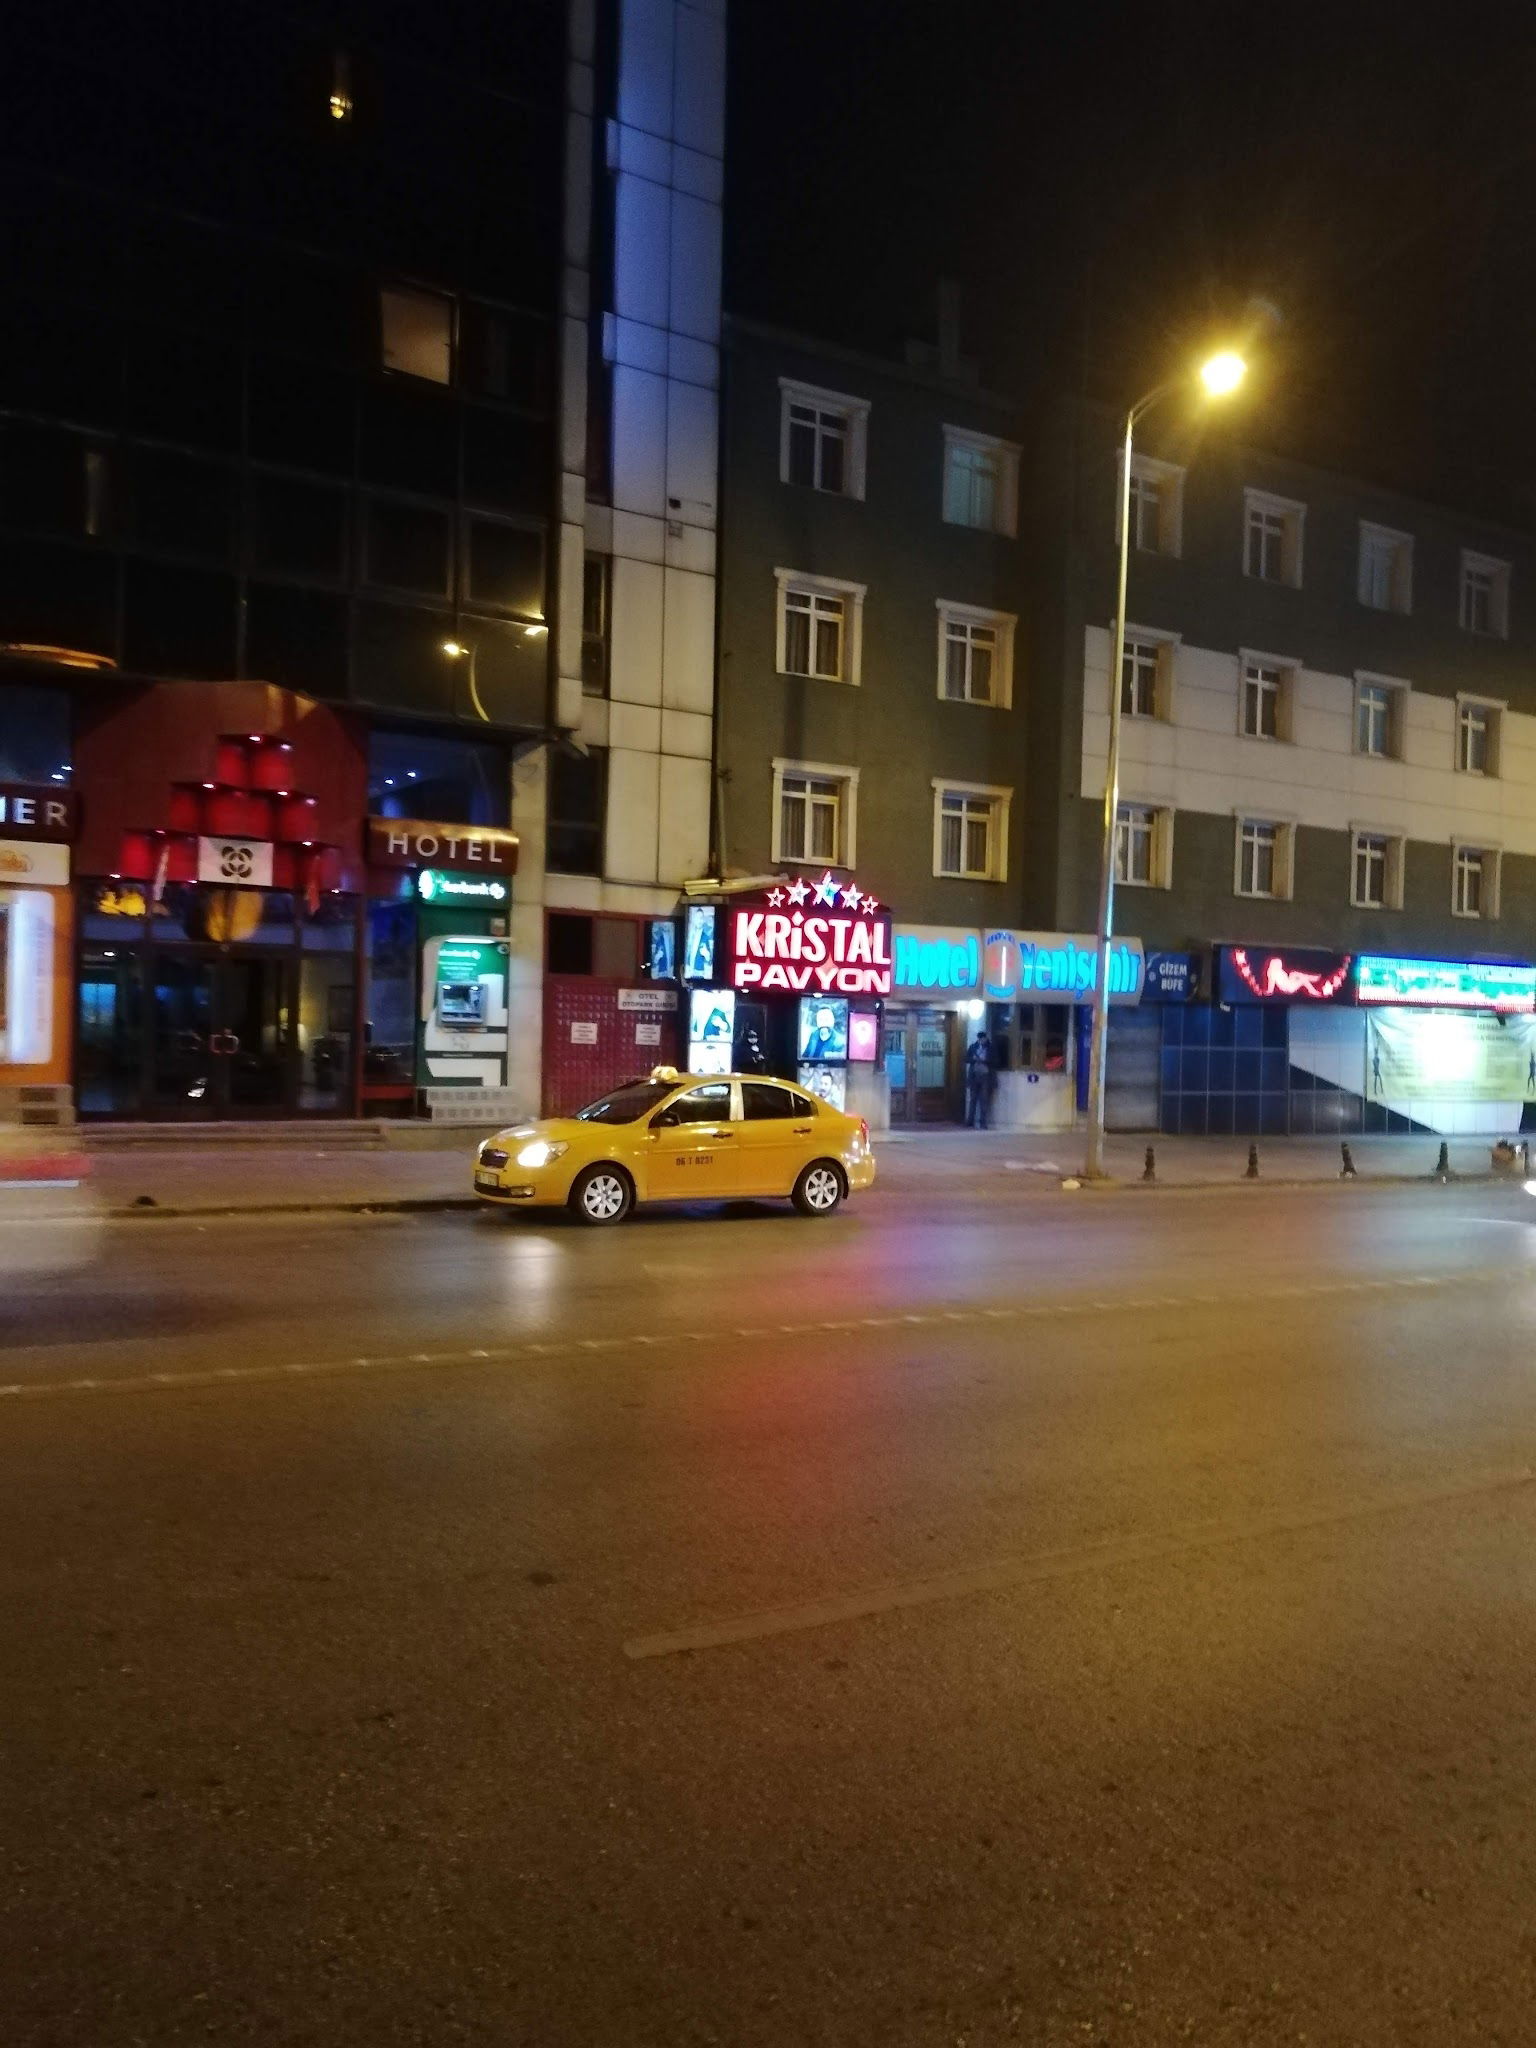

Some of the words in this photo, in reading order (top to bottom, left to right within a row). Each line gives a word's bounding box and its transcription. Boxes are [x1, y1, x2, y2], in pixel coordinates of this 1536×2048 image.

[388, 831, 503, 863] HOTEL
[734, 962, 891, 993] PAVYON
[895, 935, 978, 988] Hotel
